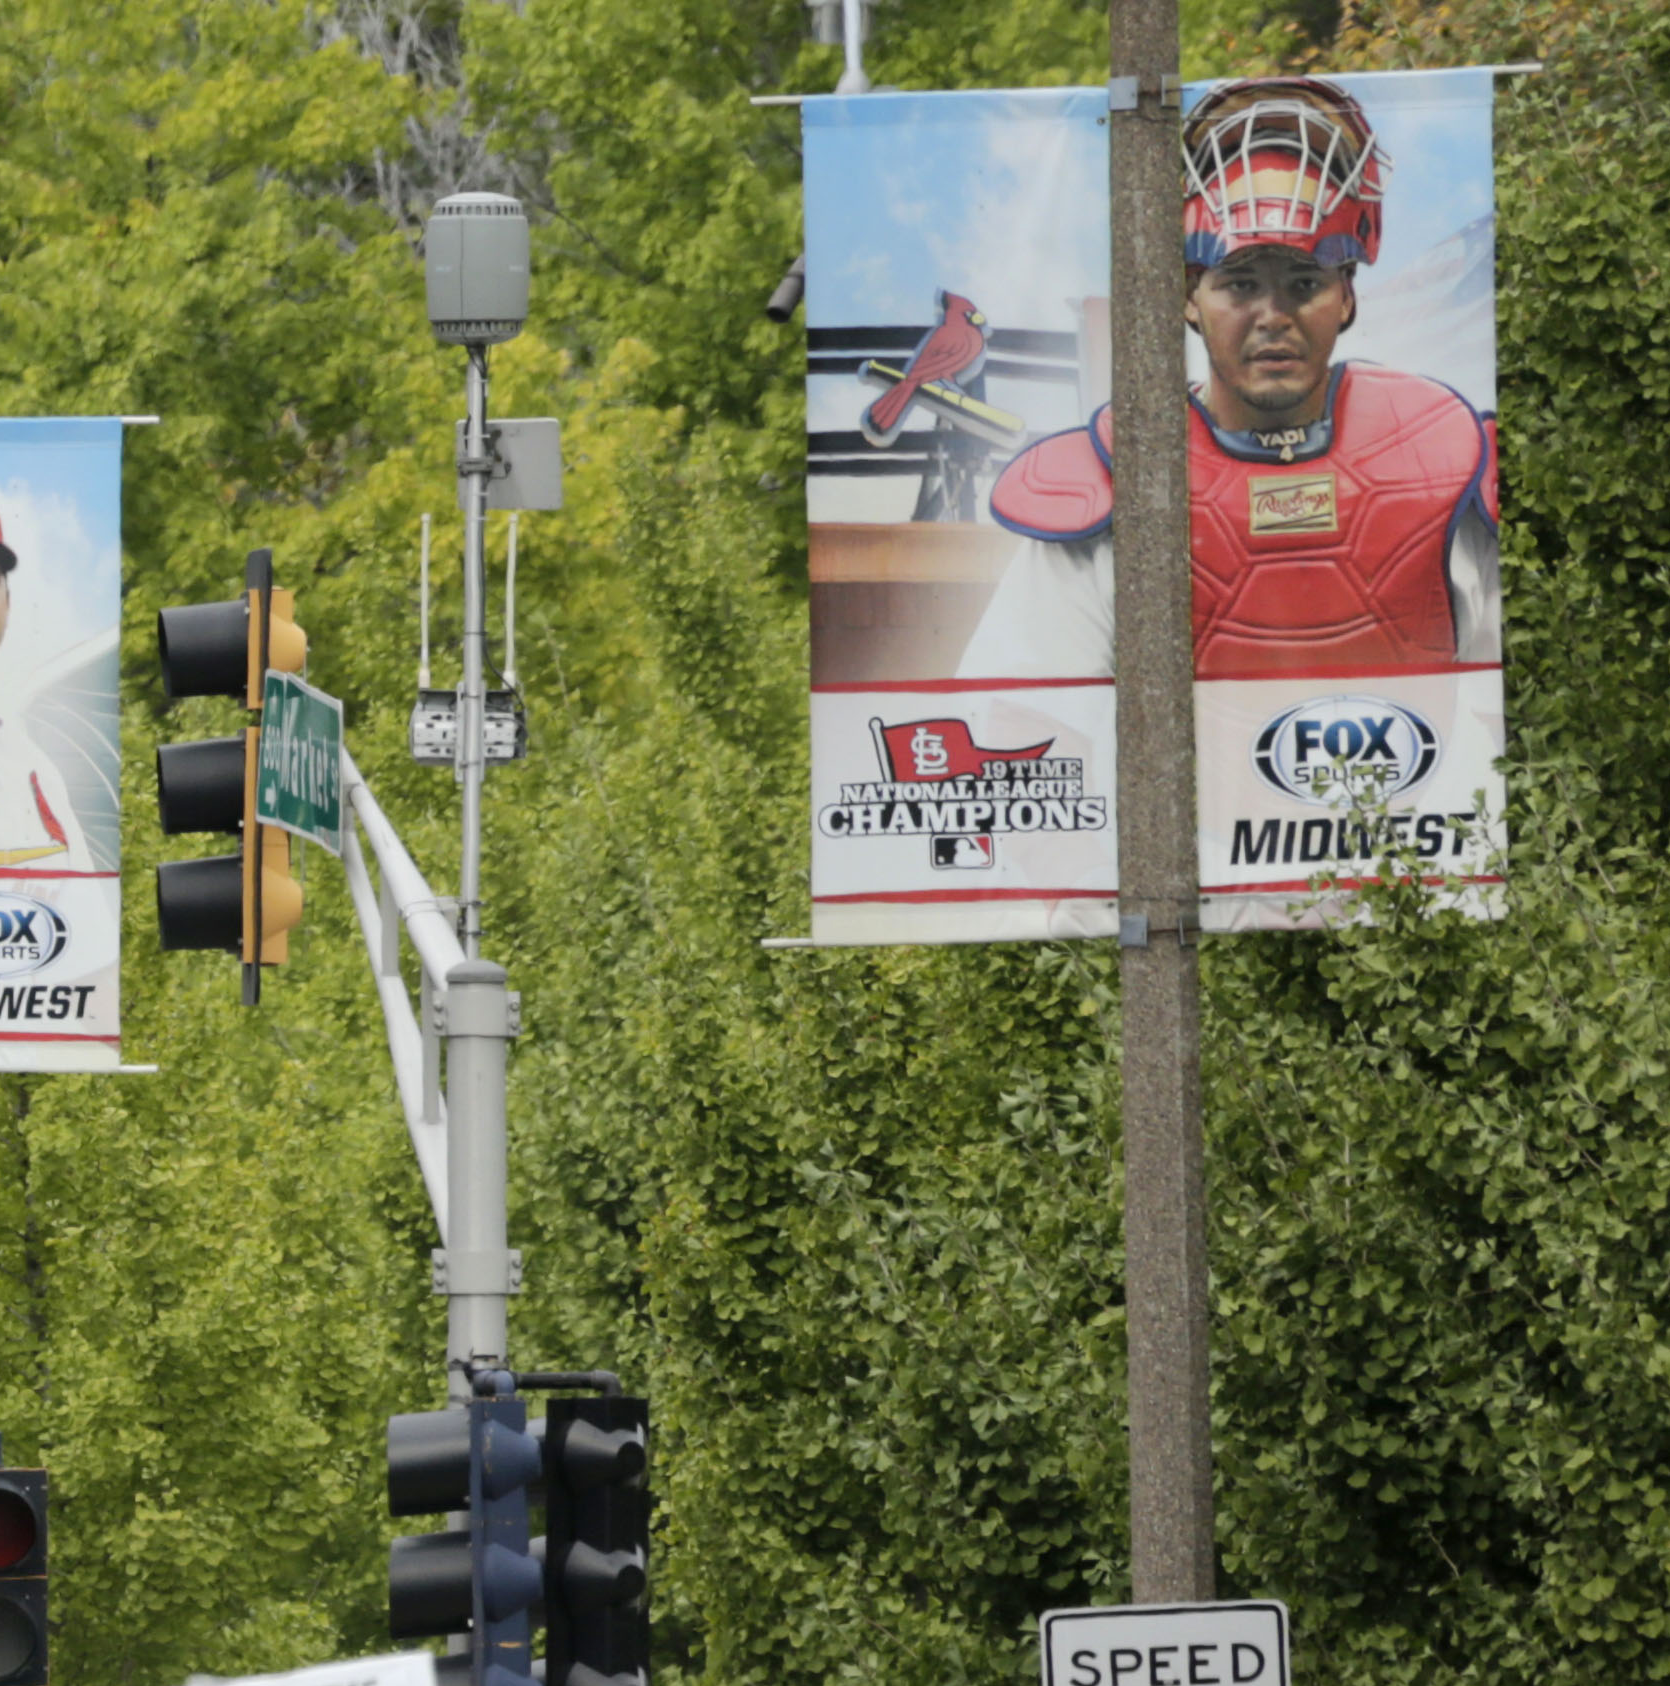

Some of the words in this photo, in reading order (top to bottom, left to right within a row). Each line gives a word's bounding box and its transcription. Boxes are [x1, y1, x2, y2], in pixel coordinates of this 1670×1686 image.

[1257, 427, 1306, 449] YADI
[1294, 717, 1399, 763] FOX
[981, 760, 1008, 780] 19
[1010, 758, 1082, 779] TIME
[841, 777, 975, 802] NATIONAL
[975, 779, 1082, 801] LEAGUE
[818, 797, 1107, 838] CHAMPIONS
